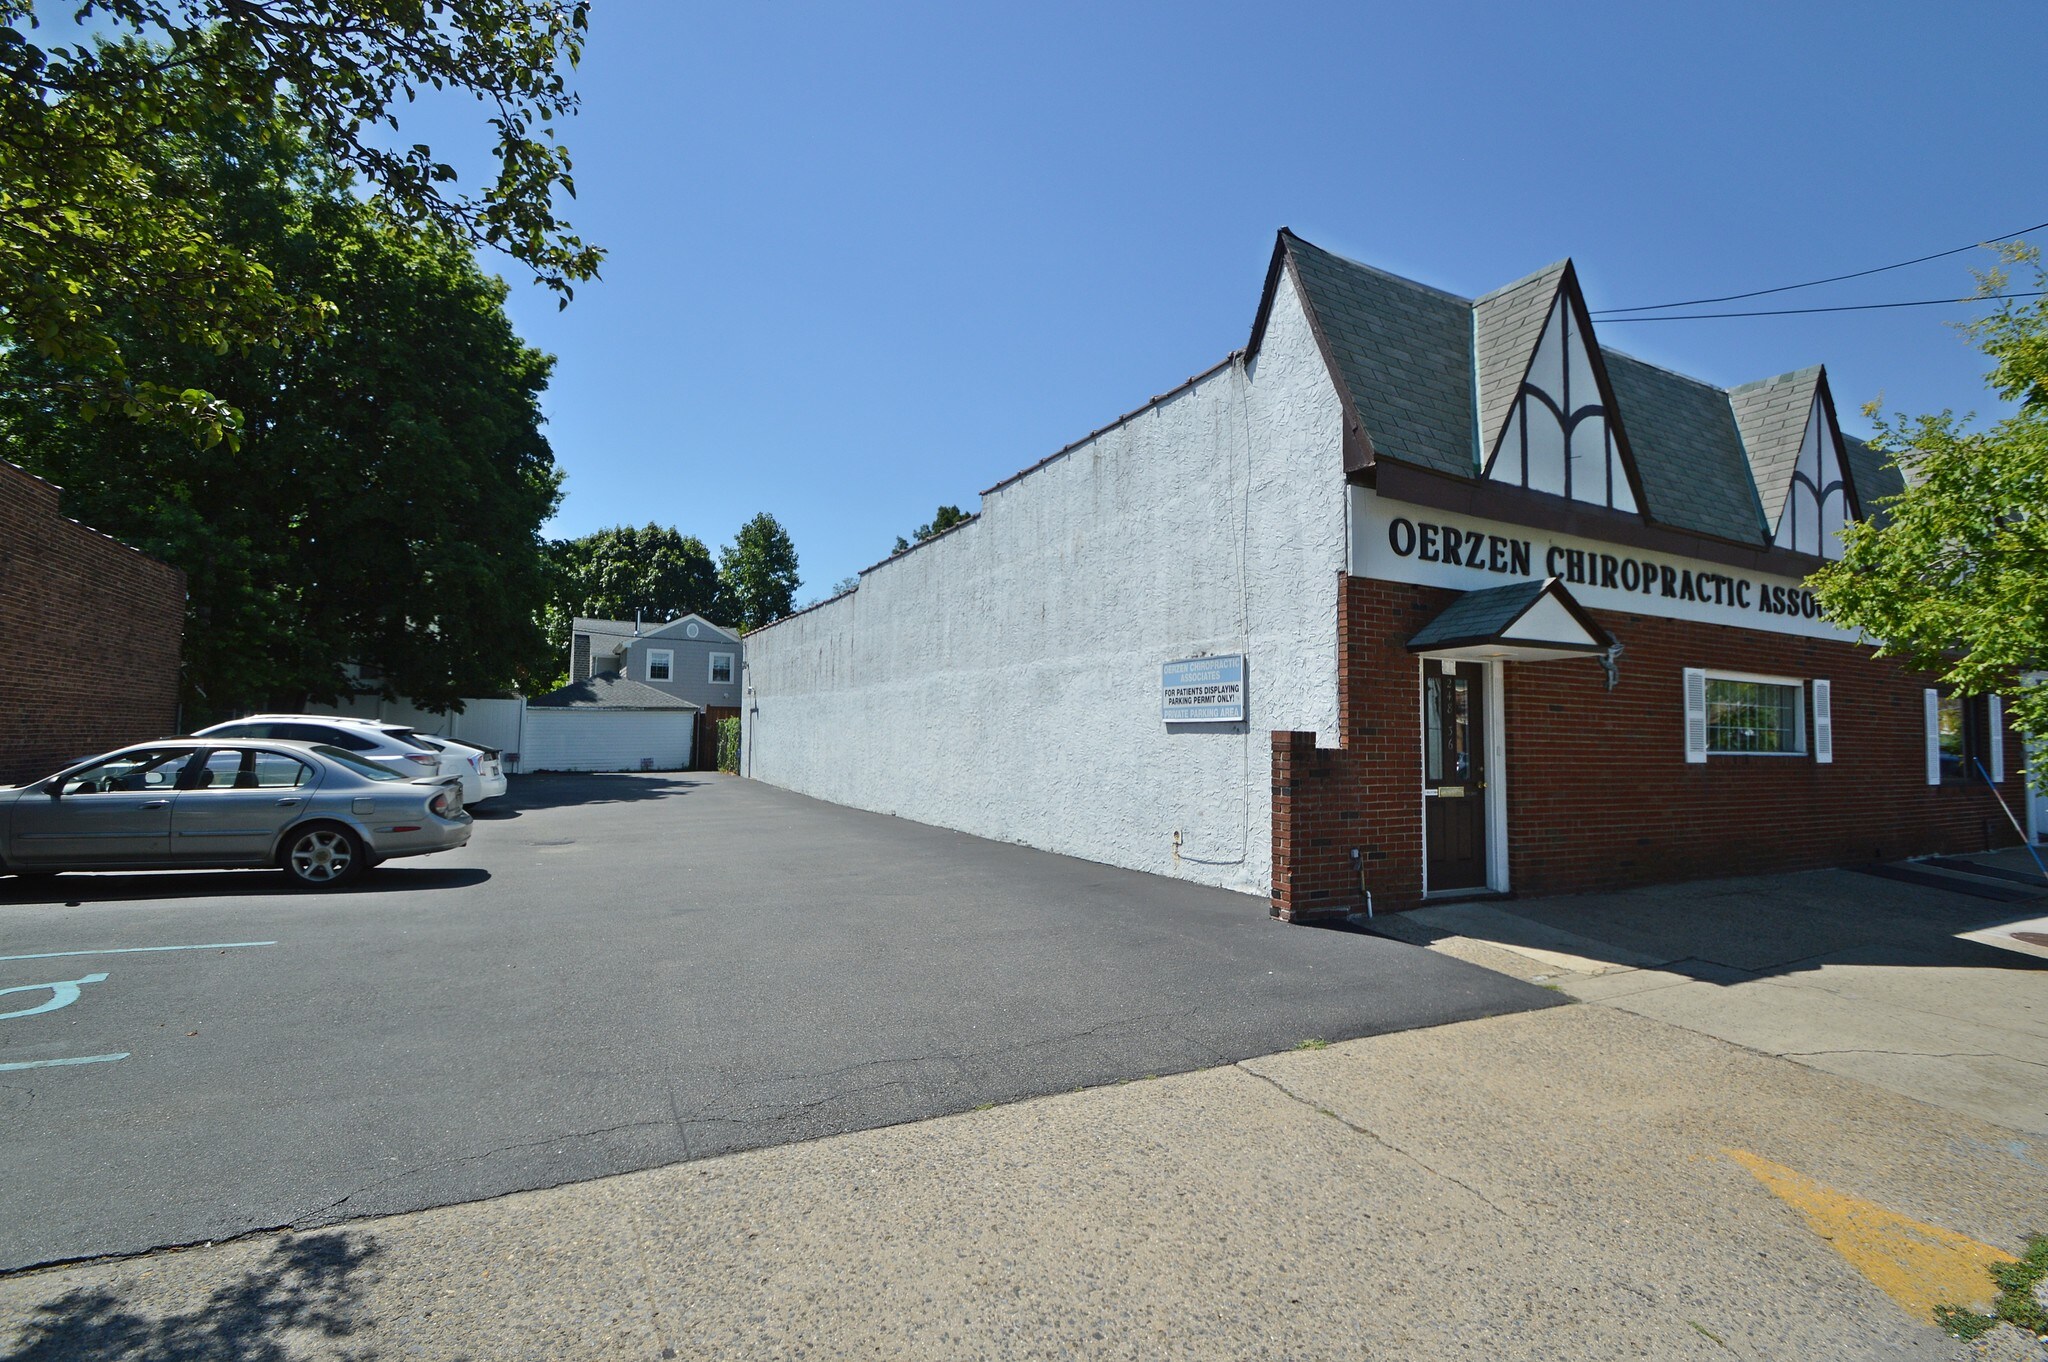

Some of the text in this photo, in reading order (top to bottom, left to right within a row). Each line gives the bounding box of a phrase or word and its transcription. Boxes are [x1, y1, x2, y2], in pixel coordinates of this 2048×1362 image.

[1388, 517, 1531, 576] OERZEN
[1546, 545, 1751, 609] CHIROPRACTIC
[1164, 658, 1240, 674] OERZEN CHIROPRACTIC
[1181, 671, 1220, 682] ASSOCIATES
[1164, 684, 1239, 697] FOR PATIENTS DISPLAYING
[1168, 694, 1235, 705] PARKING PERMIT ONLY!
[1164, 707, 1239, 719] PRIVATE PARKING AREA
